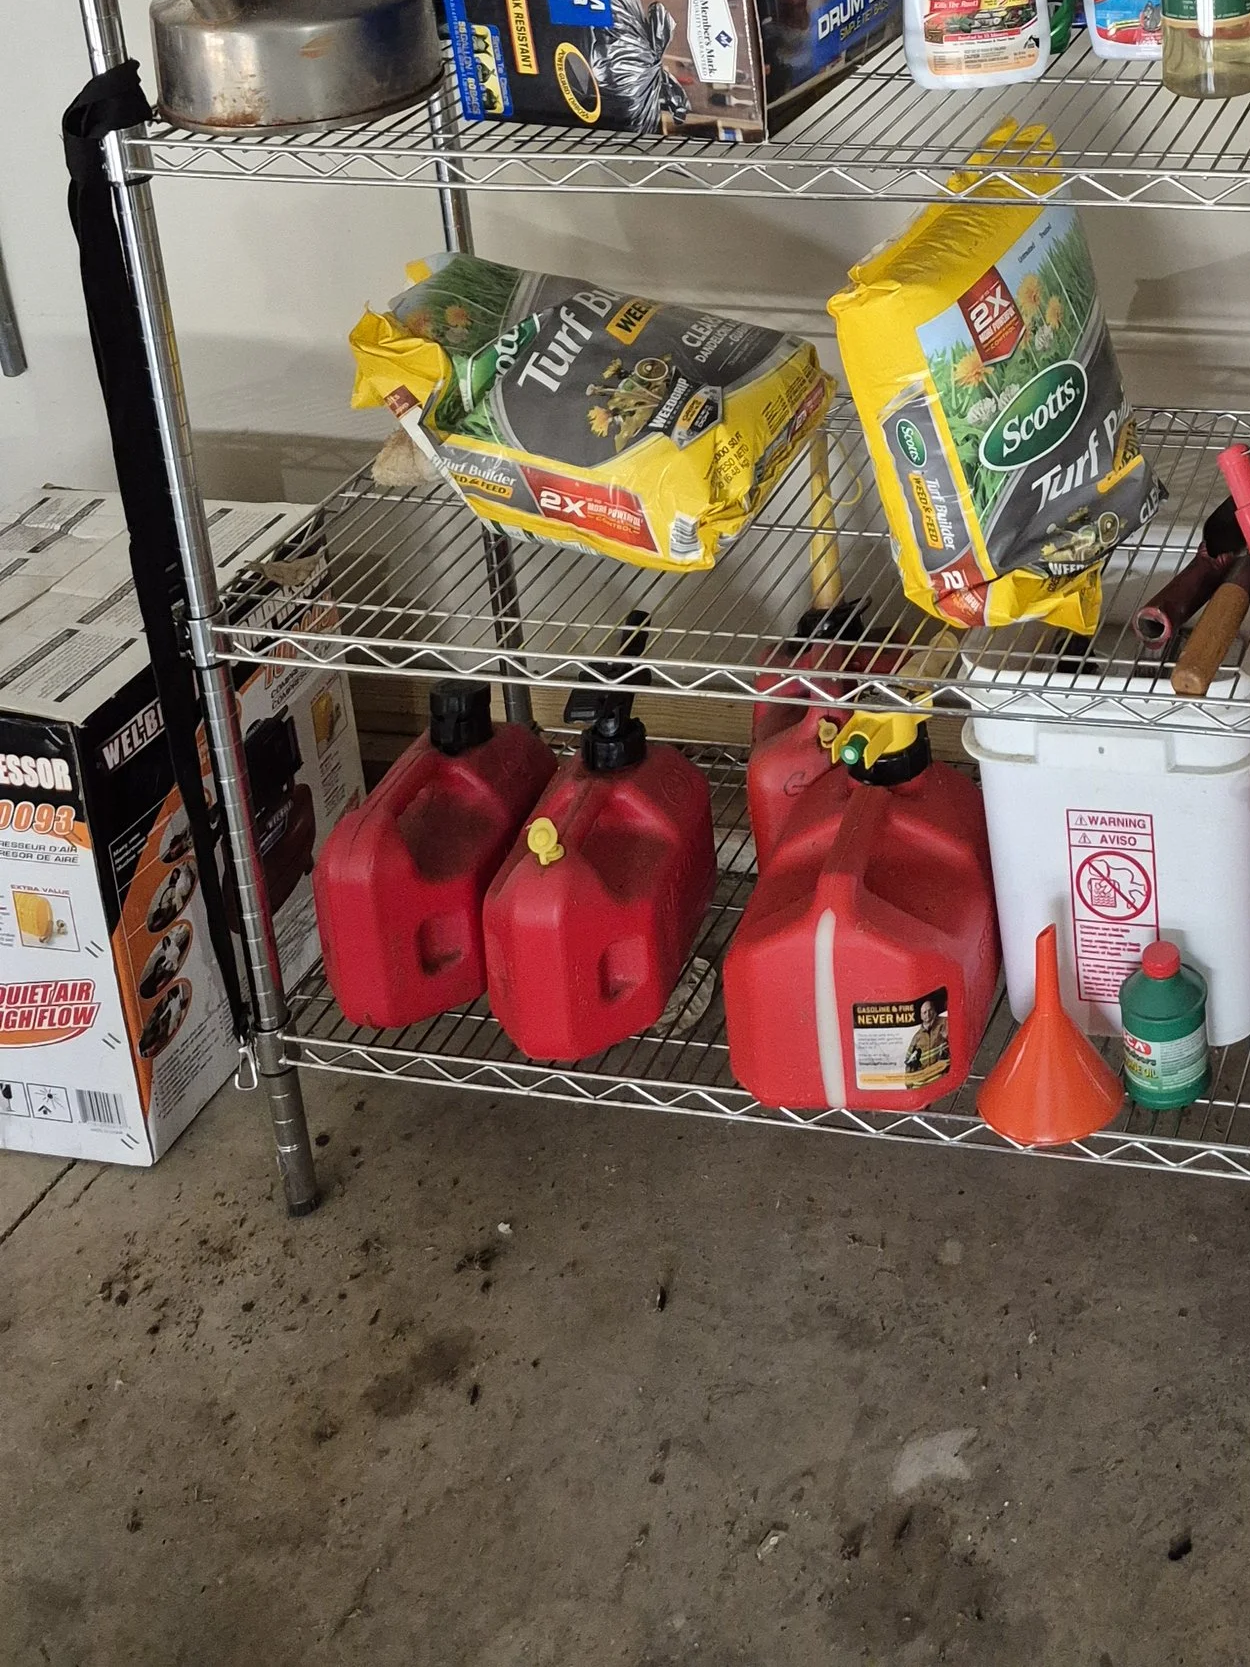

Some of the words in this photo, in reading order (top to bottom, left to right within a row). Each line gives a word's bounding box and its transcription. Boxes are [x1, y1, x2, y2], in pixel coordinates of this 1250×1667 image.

[693, 0, 702, 28] QUALITY
[700, 0, 712, 47] Member's
[460, 33, 474, 71] GALLON
[513, 11, 533, 70] RESISTANT
[697, 30, 709, 76] GUARANTEED
[970, 285, 1011, 334] 2X
[518, 304, 592, 393] Turf
[990, 325, 1016, 350] CONTROL
[648, 376, 690, 429] WEEDGRIP
[1002, 377, 1076, 457] Scotts
[902, 425, 921, 463] Scotts
[439, 455, 467, 475] Turf
[470, 462, 517, 486] Builder
[717, 458, 736, 477] PESO
[734, 443, 749, 461] NETO
[1031, 428, 1099, 514] Turf
[480, 480, 507, 495] FEED
[913, 477, 928, 507] WEED
[540, 489, 587, 519] 2X
[922, 504, 933, 515] &
[926, 478, 945, 506] Turf
[937, 505, 955, 550] Builder
[595, 514, 635, 534] CONTROL
[926, 514, 939, 543] FEED
[1088, 815, 1147, 830] WARNING
[49, 845, 79, 855] D'AIR
[1100, 834, 1138, 847] AVISO
[36, 853, 51, 862] DE
[53, 855, 79, 865] AIRE
[10, 884, 40, 893] EXTRA
[42, 887, 71, 896] VALUE
[54, 982, 92, 1003] AIR
[37, 1005, 97, 1028] FLOW
[857, 1005, 891, 1014] GASOLINE
[891, 1005, 898, 1013] &
[899, 1003, 915, 1013] FIRE
[857, 1014, 893, 1025] NEVER
[896, 1012, 916, 1024] MIX
